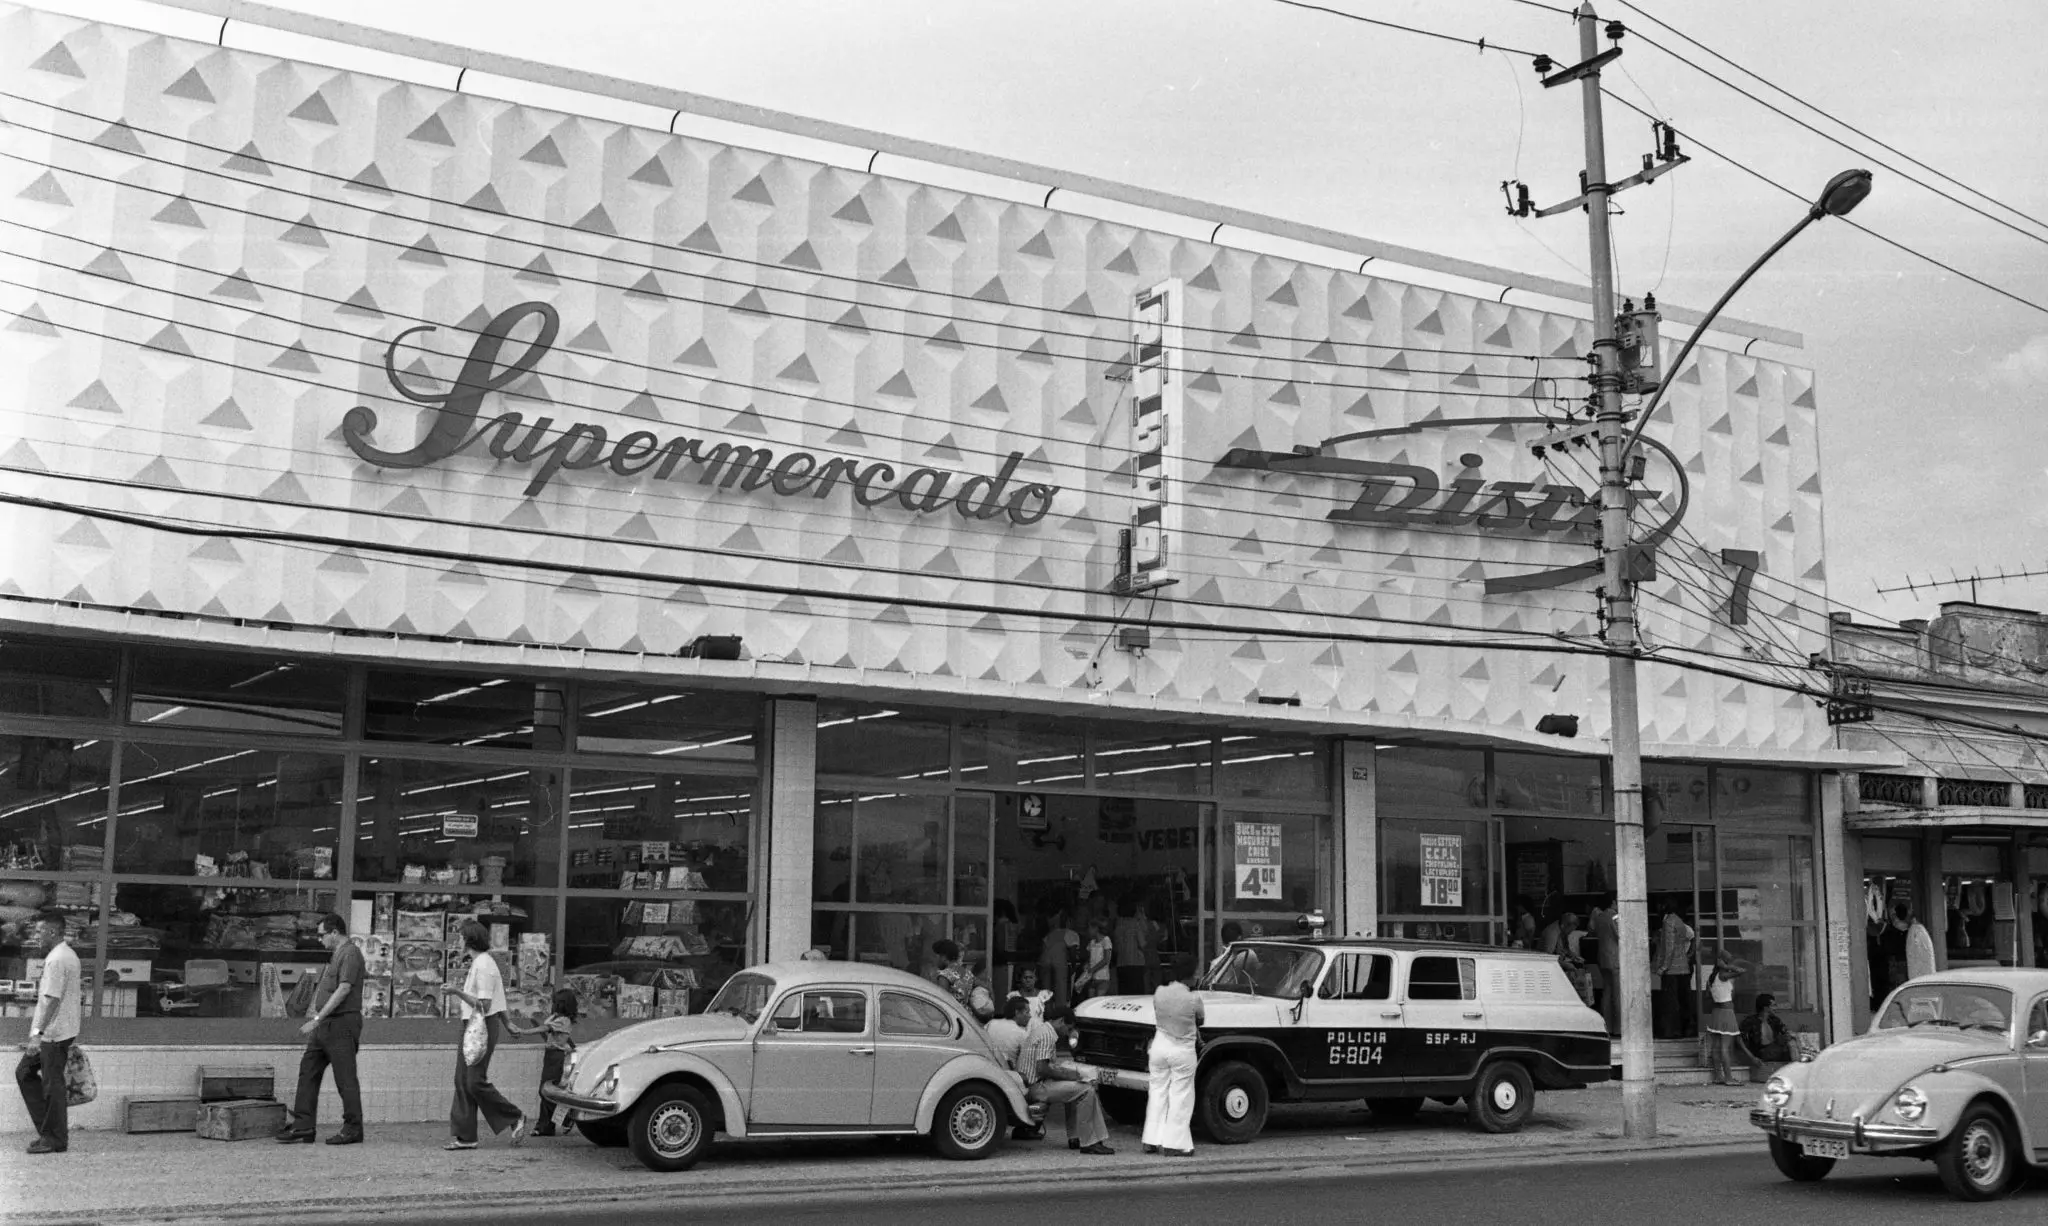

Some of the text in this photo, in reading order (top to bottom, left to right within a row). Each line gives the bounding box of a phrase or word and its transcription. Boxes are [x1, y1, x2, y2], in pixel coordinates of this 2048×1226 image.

[342, 302, 1061, 525] Supermercado
[1722, 548, 1759, 625] 7
[1327, 1031, 1387, 1043] POLICIA
[1329, 1046, 1383, 1065] 6-804
